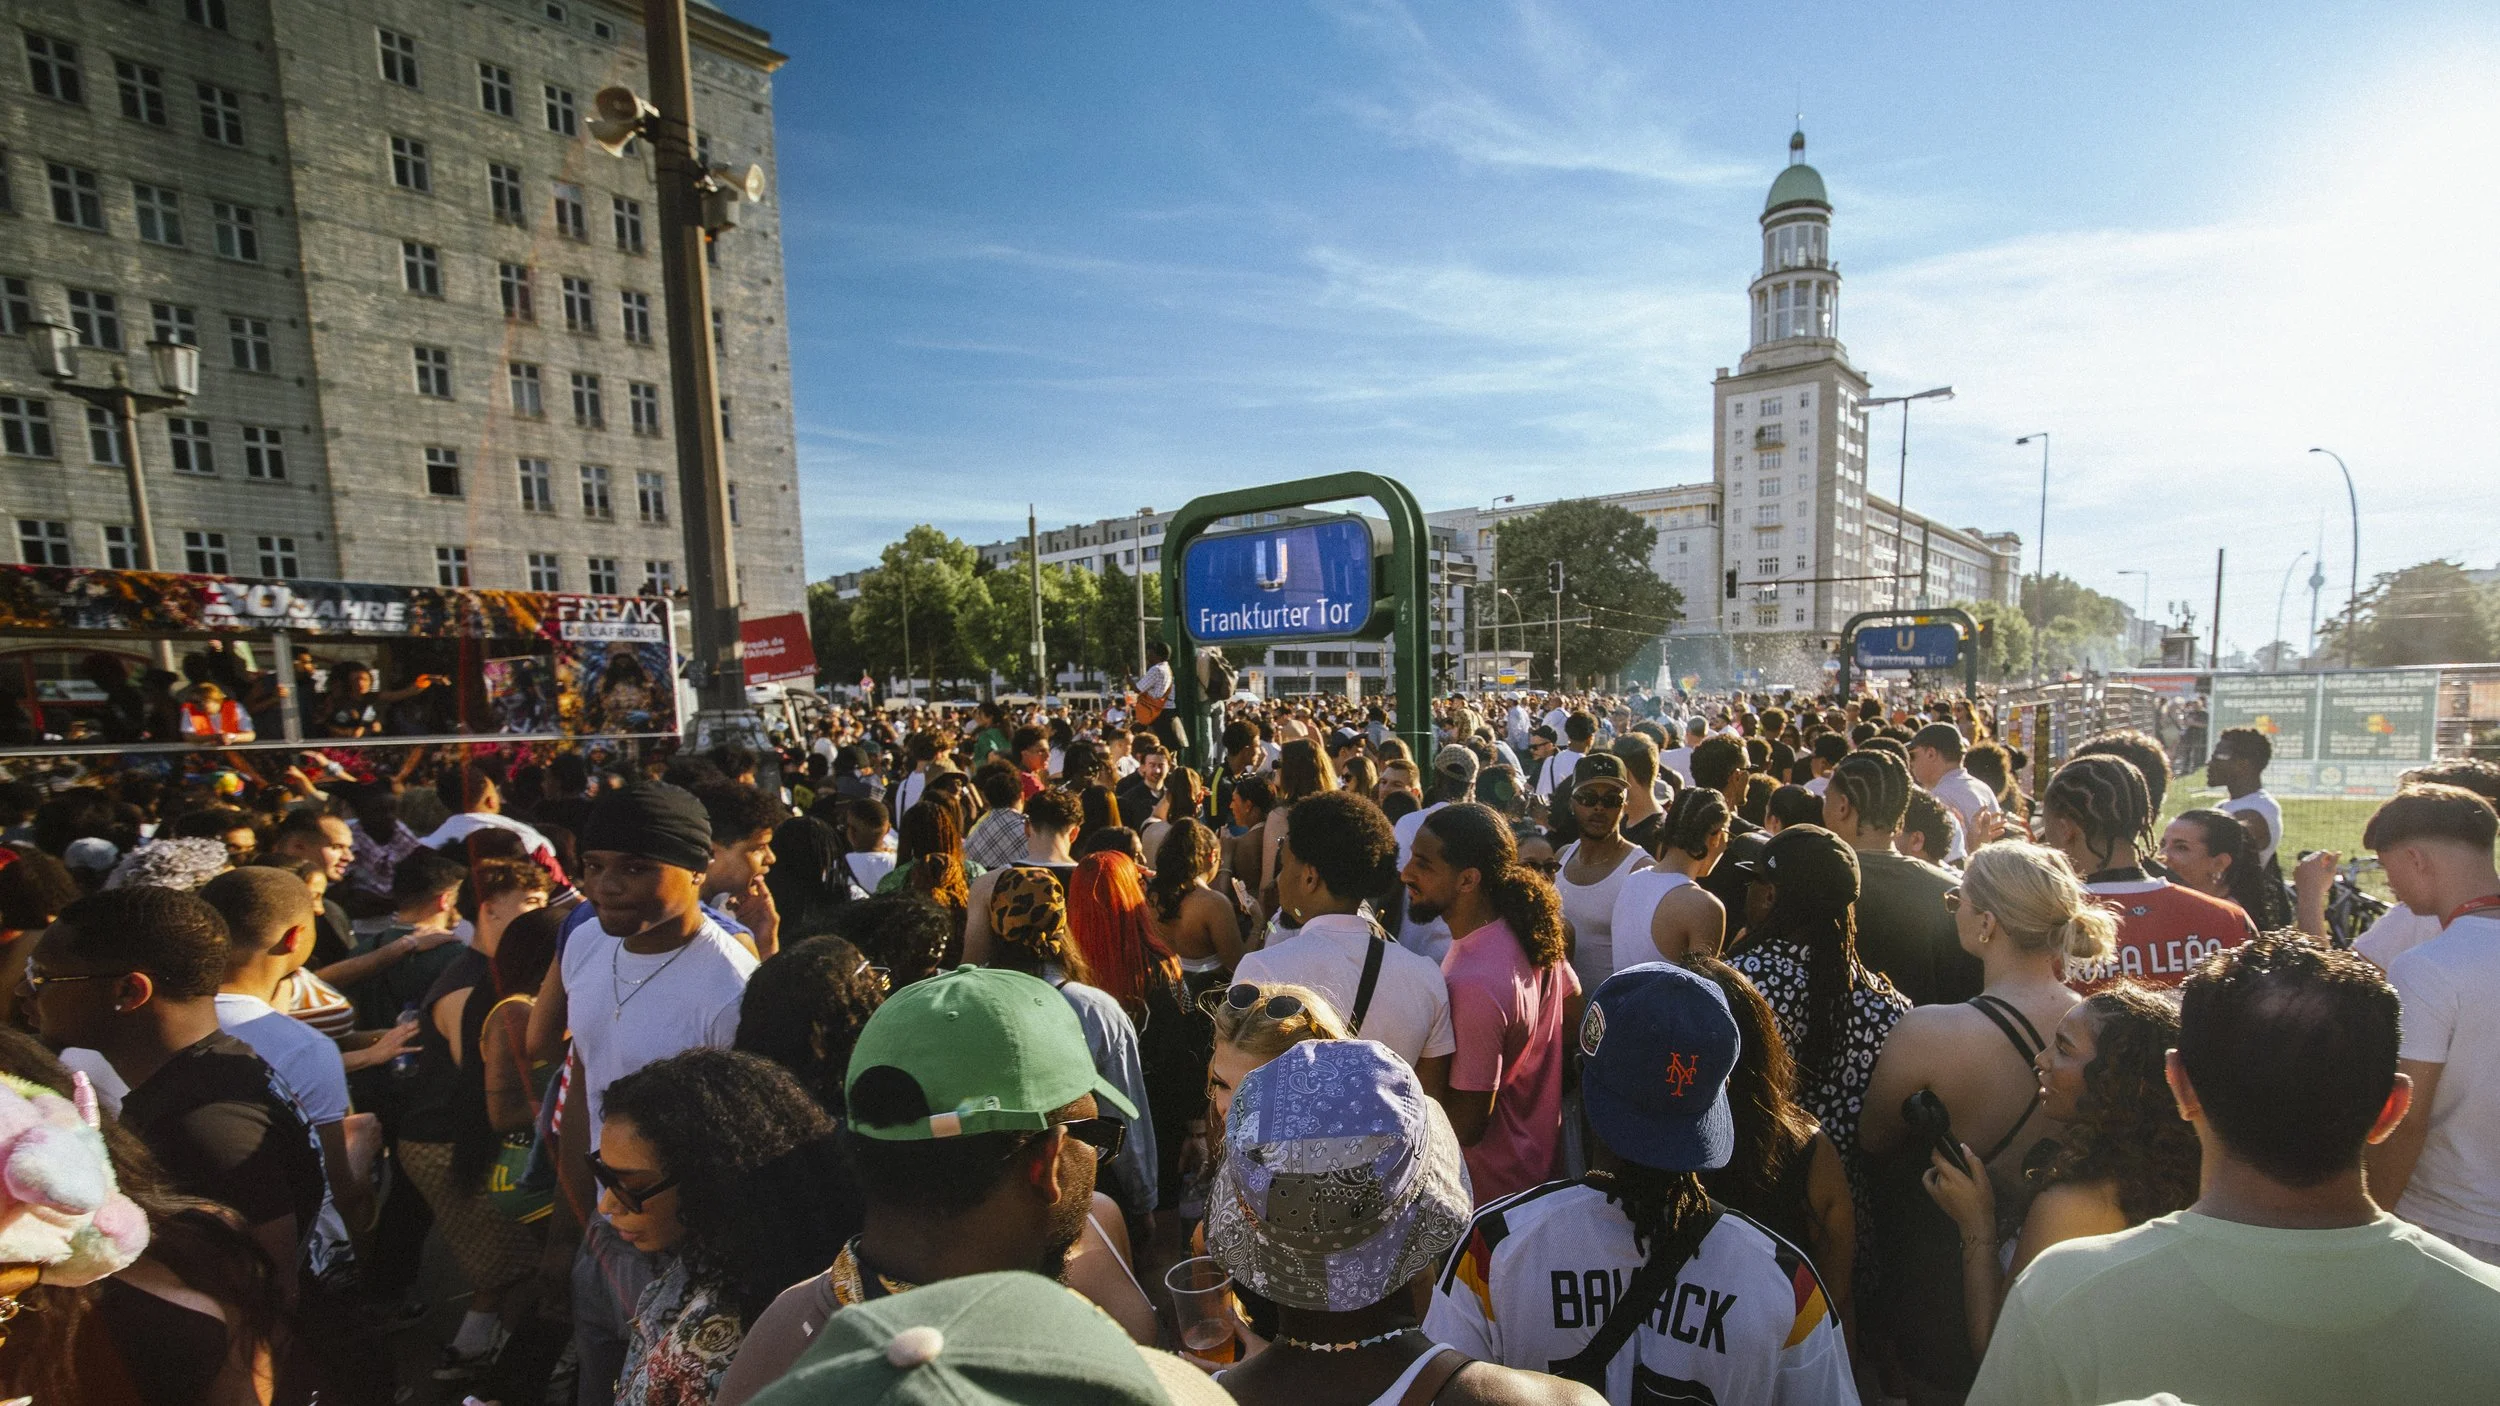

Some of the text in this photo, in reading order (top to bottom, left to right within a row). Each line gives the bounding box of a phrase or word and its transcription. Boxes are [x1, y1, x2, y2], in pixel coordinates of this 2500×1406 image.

[1255, 537, 1288, 593] U
[289, 597, 407, 622] JAHRE
[558, 597, 662, 623] FREAK
[1200, 597, 1353, 633] Frankfurter Tor
[565, 624, 585, 637] DE
[1896, 629, 1915, 651] U
[1550, 1266, 1738, 1355] BAACK
